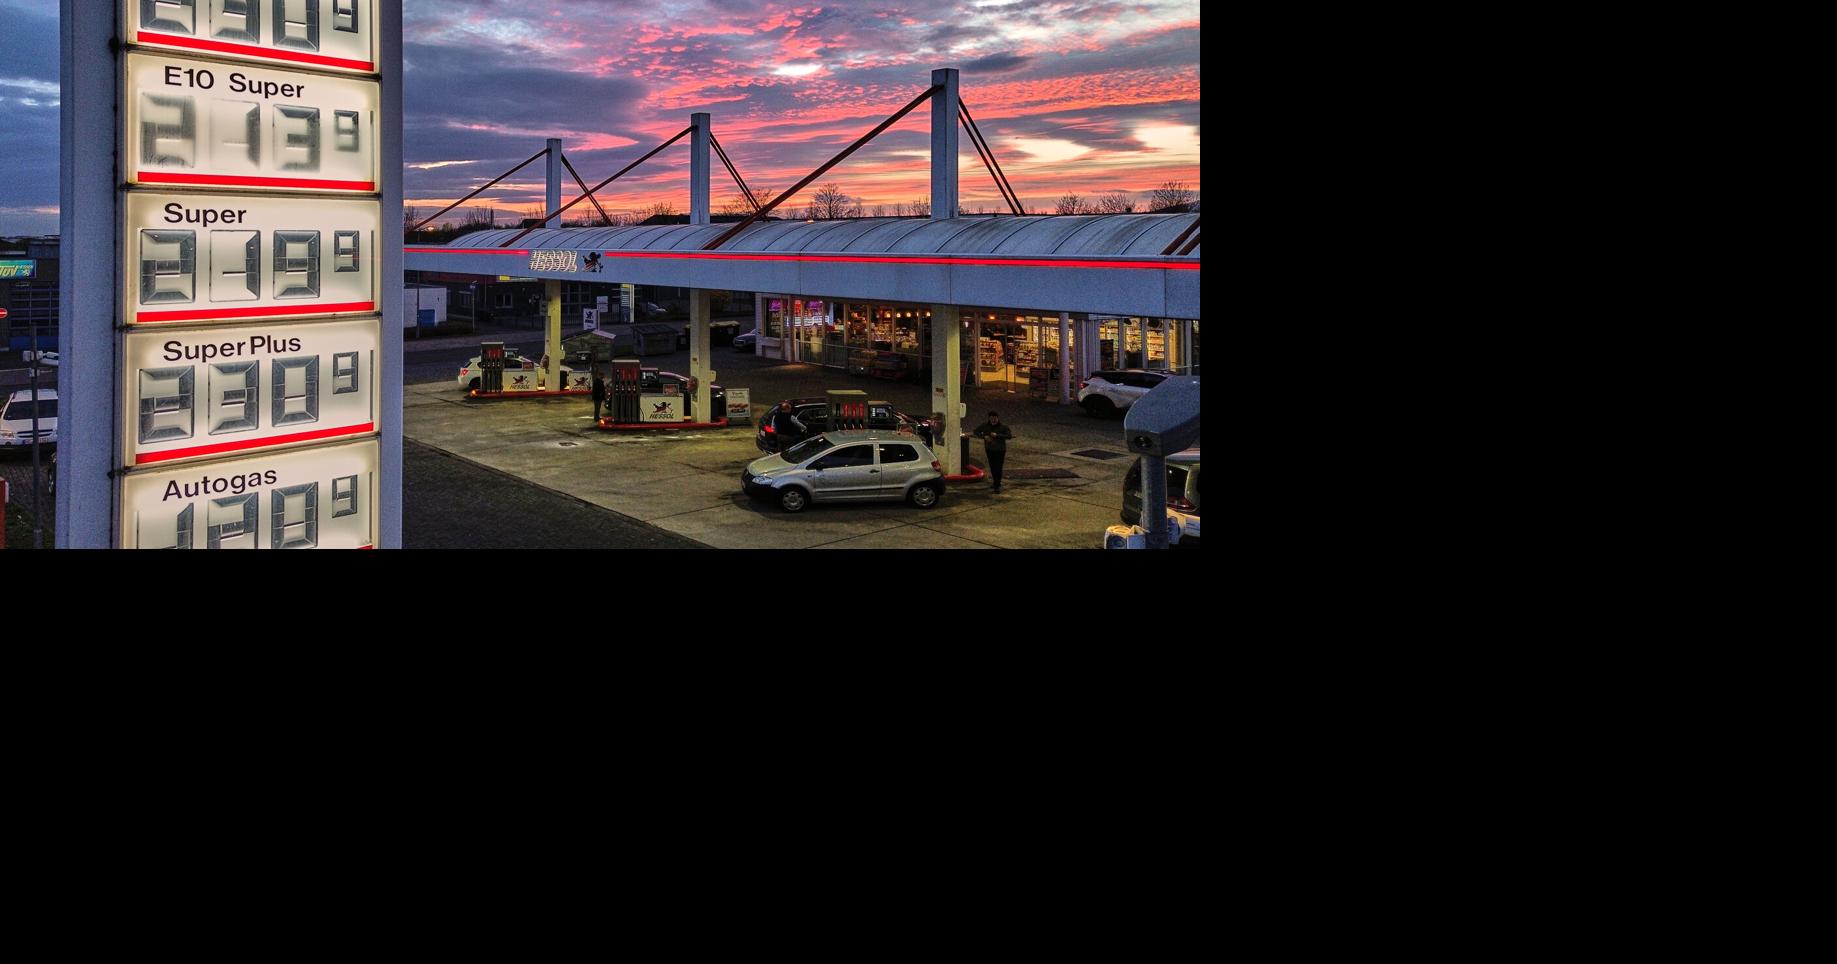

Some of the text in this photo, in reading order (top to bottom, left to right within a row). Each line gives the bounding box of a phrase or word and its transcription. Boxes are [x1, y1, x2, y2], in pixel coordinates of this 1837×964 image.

[164, 65, 305, 99] E10 Super
[163, 202, 247, 228] Super
[529, 250, 578, 273] HESSOL
[162, 469, 277, 502] Autogas
